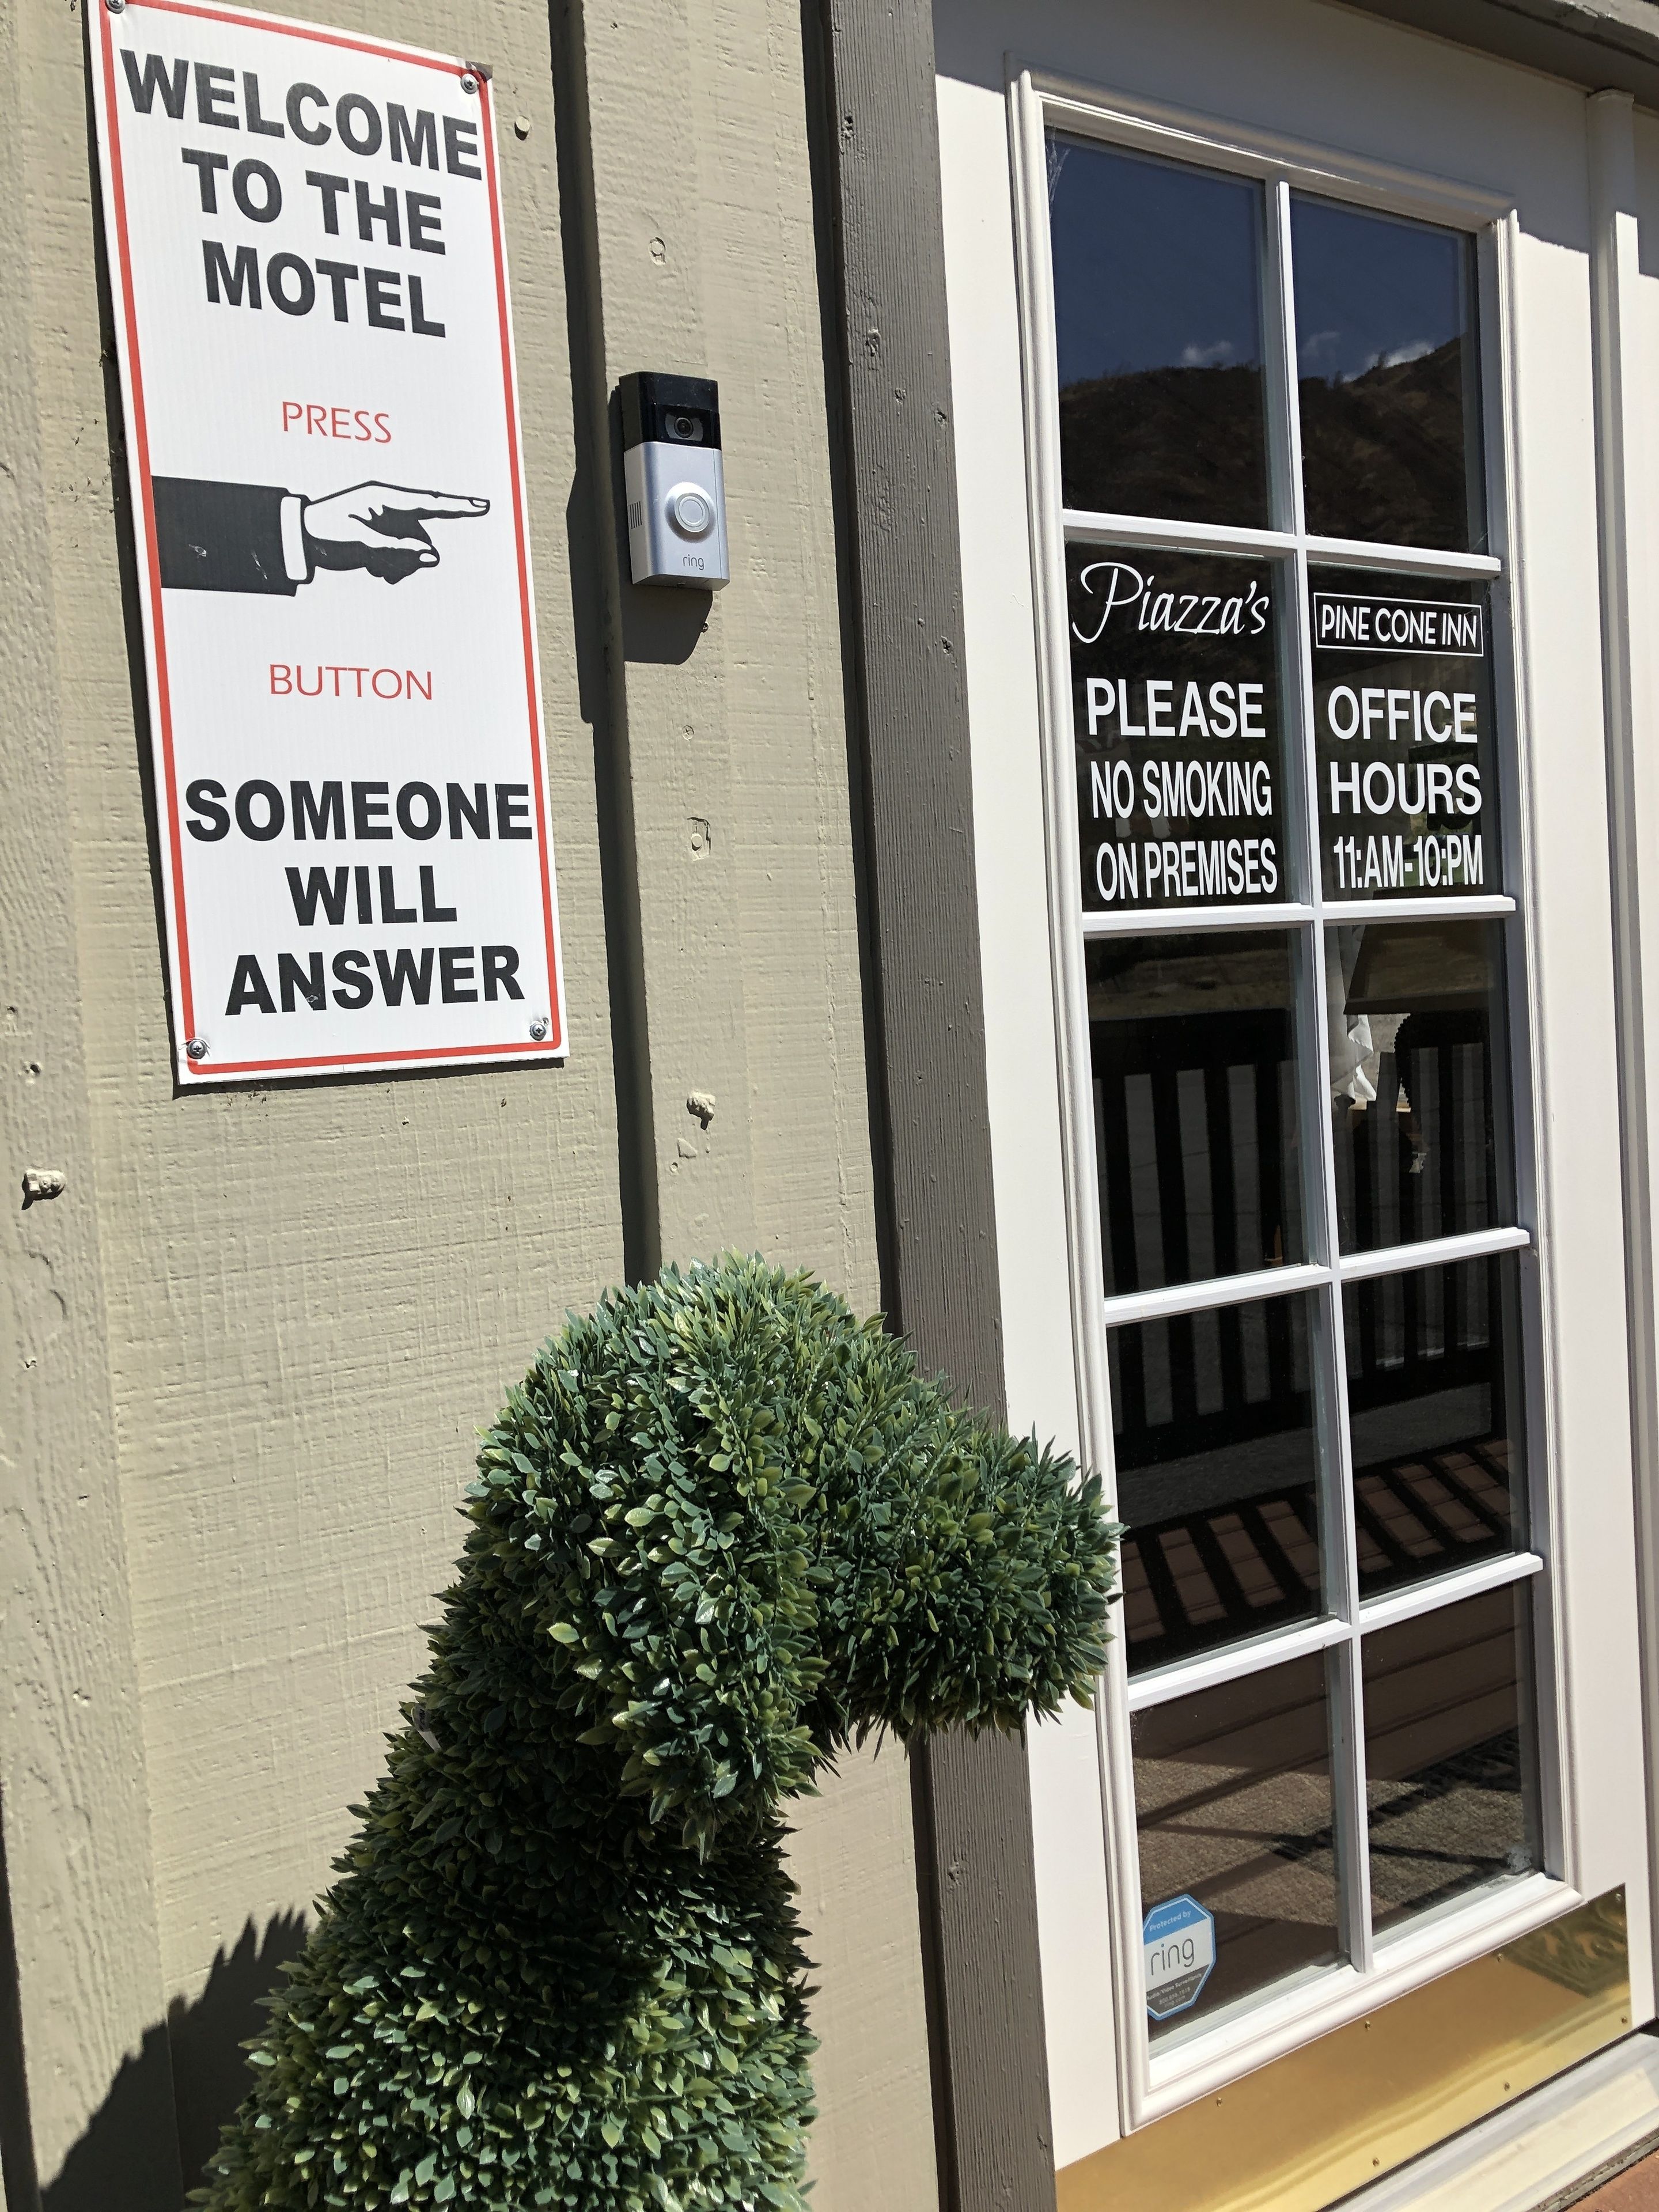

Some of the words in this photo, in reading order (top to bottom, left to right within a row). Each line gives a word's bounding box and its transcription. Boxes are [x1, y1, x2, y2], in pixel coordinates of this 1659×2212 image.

[120, 49, 482, 181] WELCOME
[181, 147, 282, 223] TO
[305, 170, 446, 256] THE
[202, 240, 446, 338] MOTEL
[282, 401, 392, 444] PRESS
[683, 554, 704, 571] ring
[1072, 562, 1269, 643] Piazza's
[1321, 604, 1371, 641] PINE
[1375, 608, 1437, 645] CONE
[1442, 612, 1477, 648] INN
[269, 663, 433, 700] BUTTON
[1086, 677, 1266, 738] PLEASE
[1328, 685, 1478, 743] OFFICE
[185, 779, 533, 842] SOMEONE
[1090, 760, 1134, 819] NO
[1142, 760, 1272, 819] SMOKING
[1330, 762, 1482, 815] HOURS
[284, 865, 457, 926] WILL
[1096, 842, 1138, 901] ON
[1144, 838, 1278, 898] PREMISES
[225, 945, 525, 1016] ANSWER
[1149, 1912, 1181, 1932] Protected
[1183, 1910, 1191, 1918] by
[1151, 1938, 1195, 1976] ring
